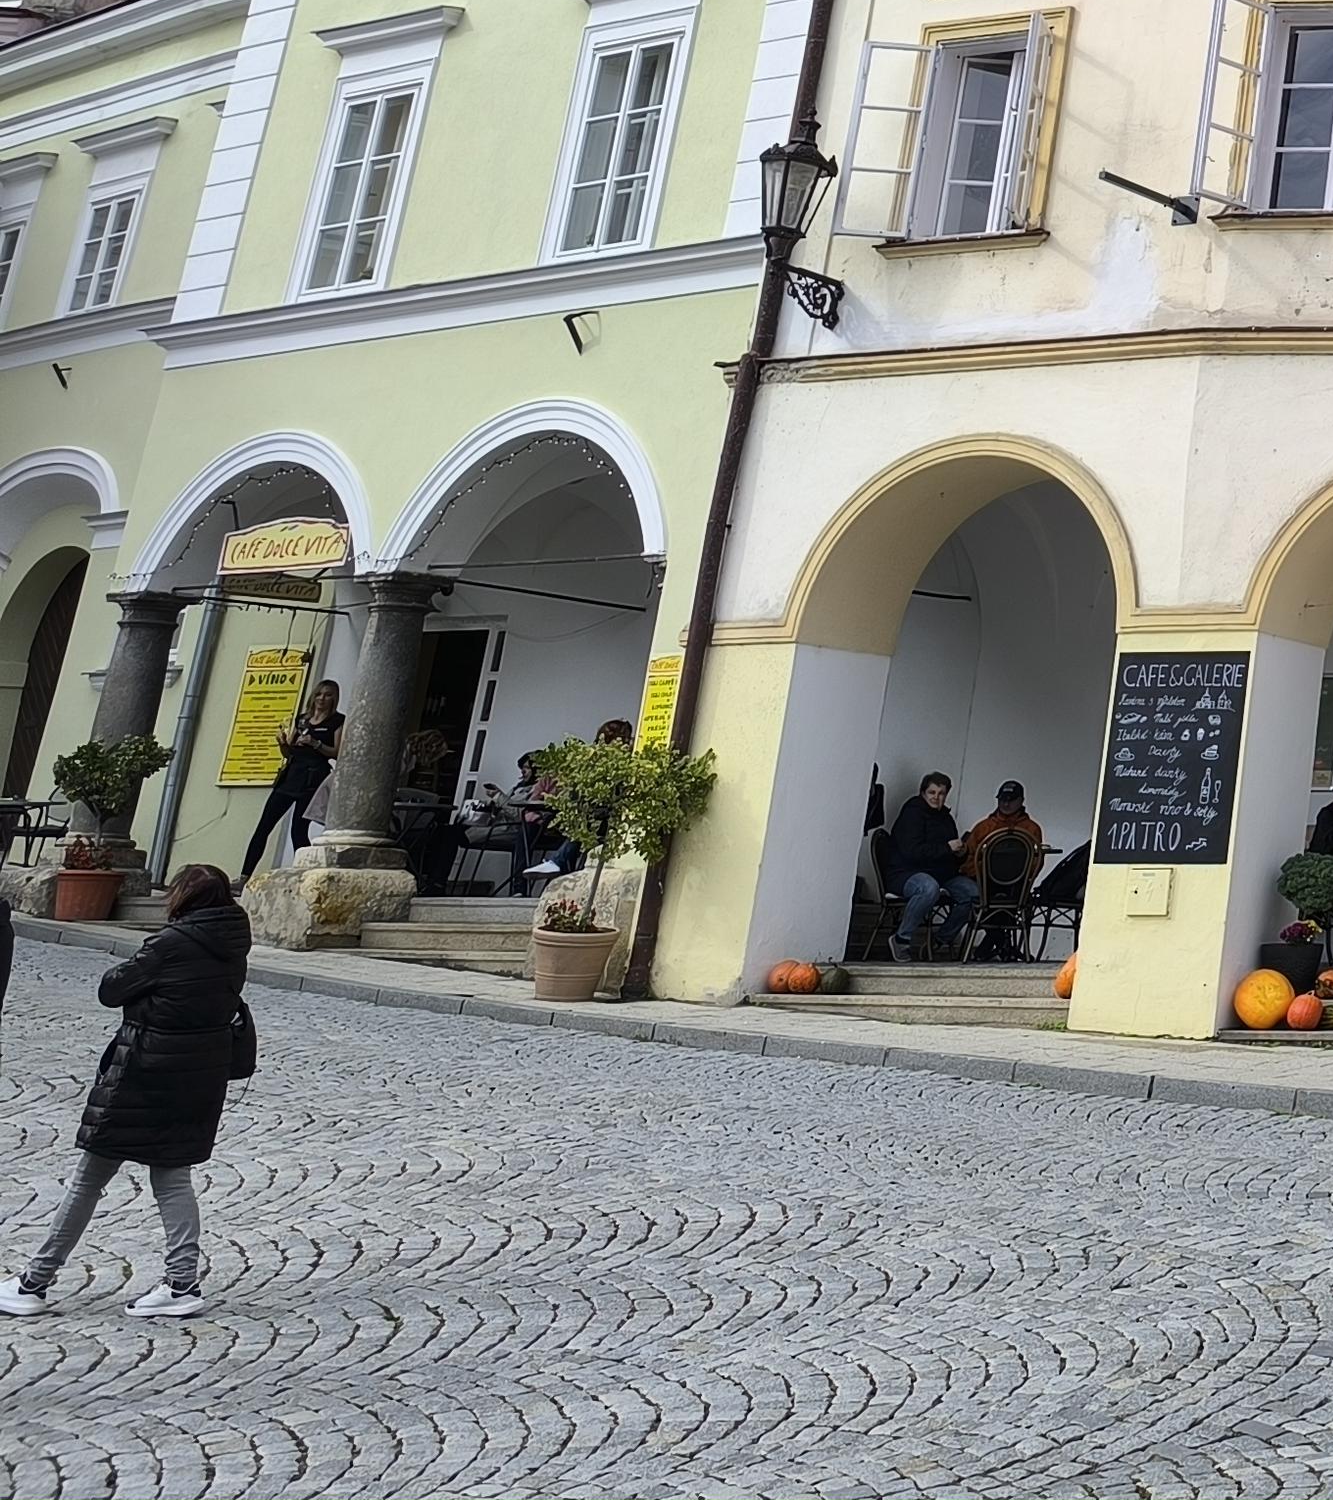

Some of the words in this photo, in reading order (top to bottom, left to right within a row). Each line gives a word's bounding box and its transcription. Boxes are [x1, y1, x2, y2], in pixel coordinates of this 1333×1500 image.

[262, 535, 305, 559] DOLCE
[304, 531, 347, 556] VITA
[286, 584, 317, 597] VITA
